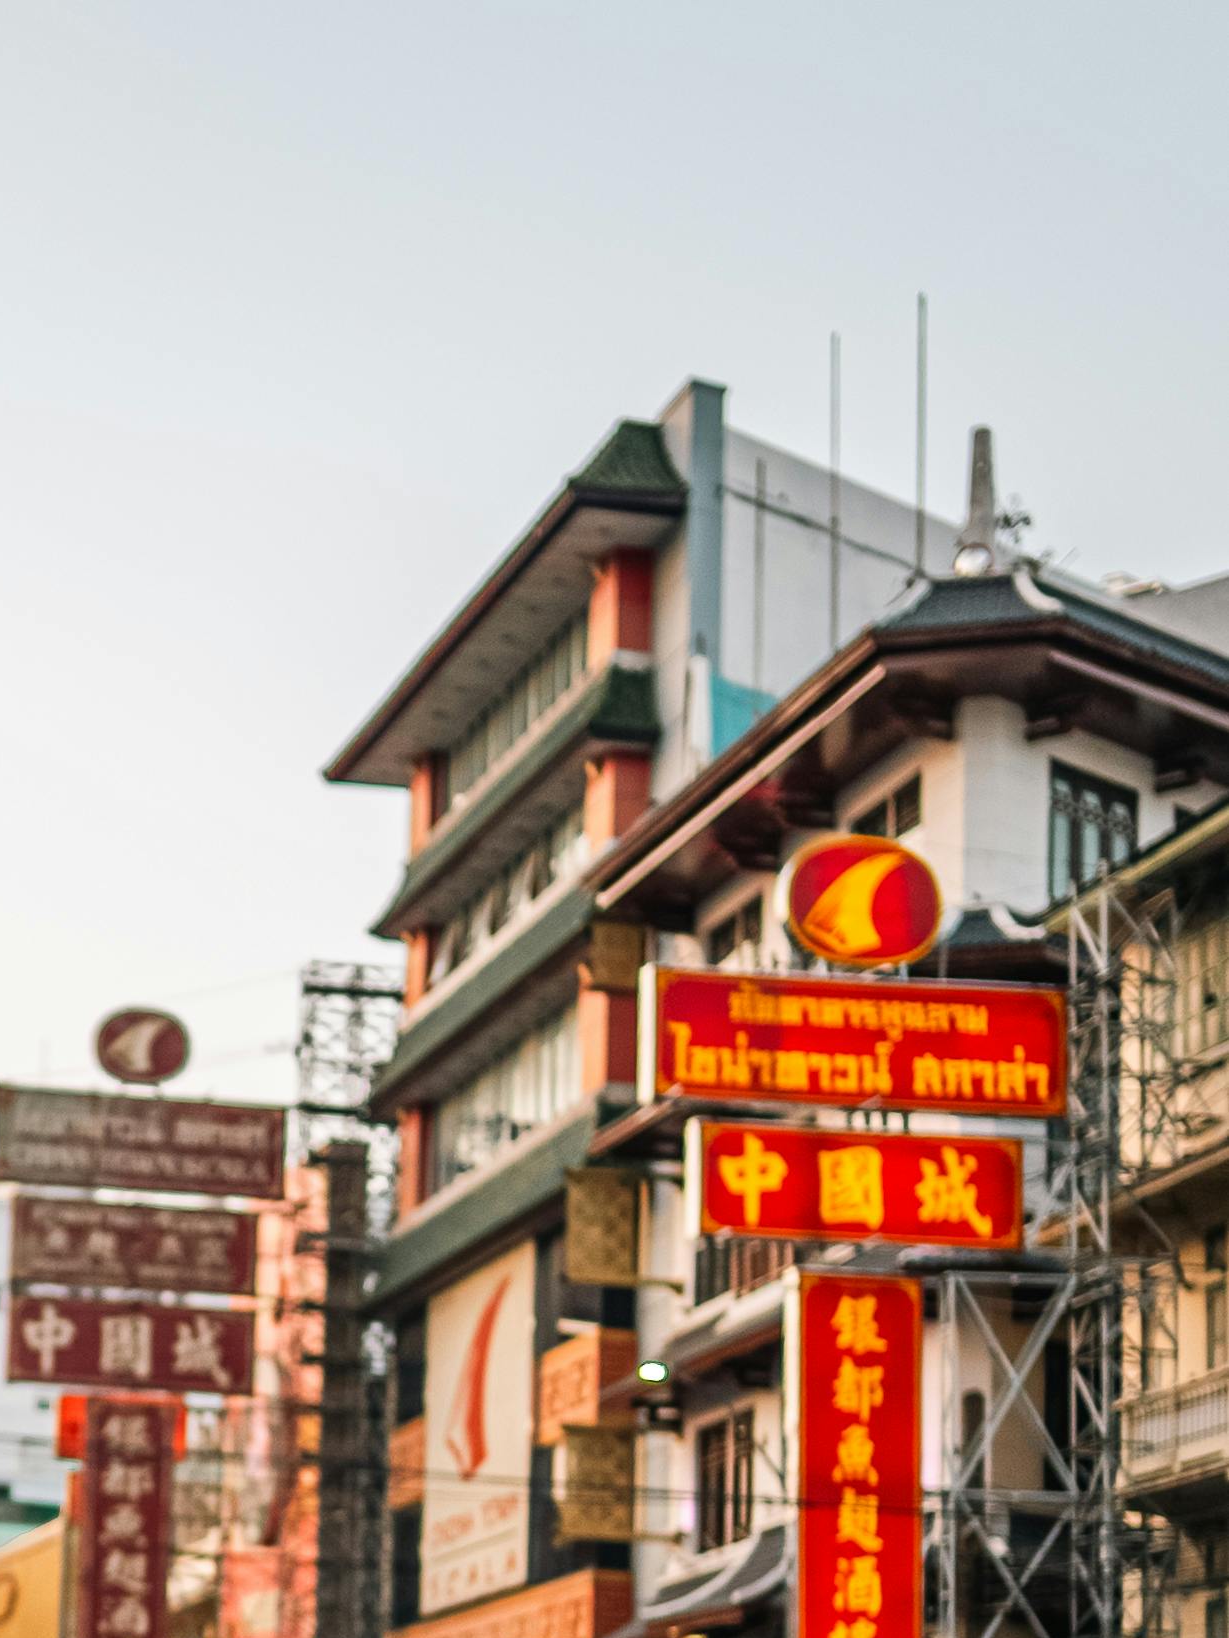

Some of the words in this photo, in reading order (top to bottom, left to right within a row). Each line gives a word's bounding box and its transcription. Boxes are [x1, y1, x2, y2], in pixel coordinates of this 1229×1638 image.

[718, 1132, 992, 1238] 中國城
[22, 1303, 231, 1387] 中國城
